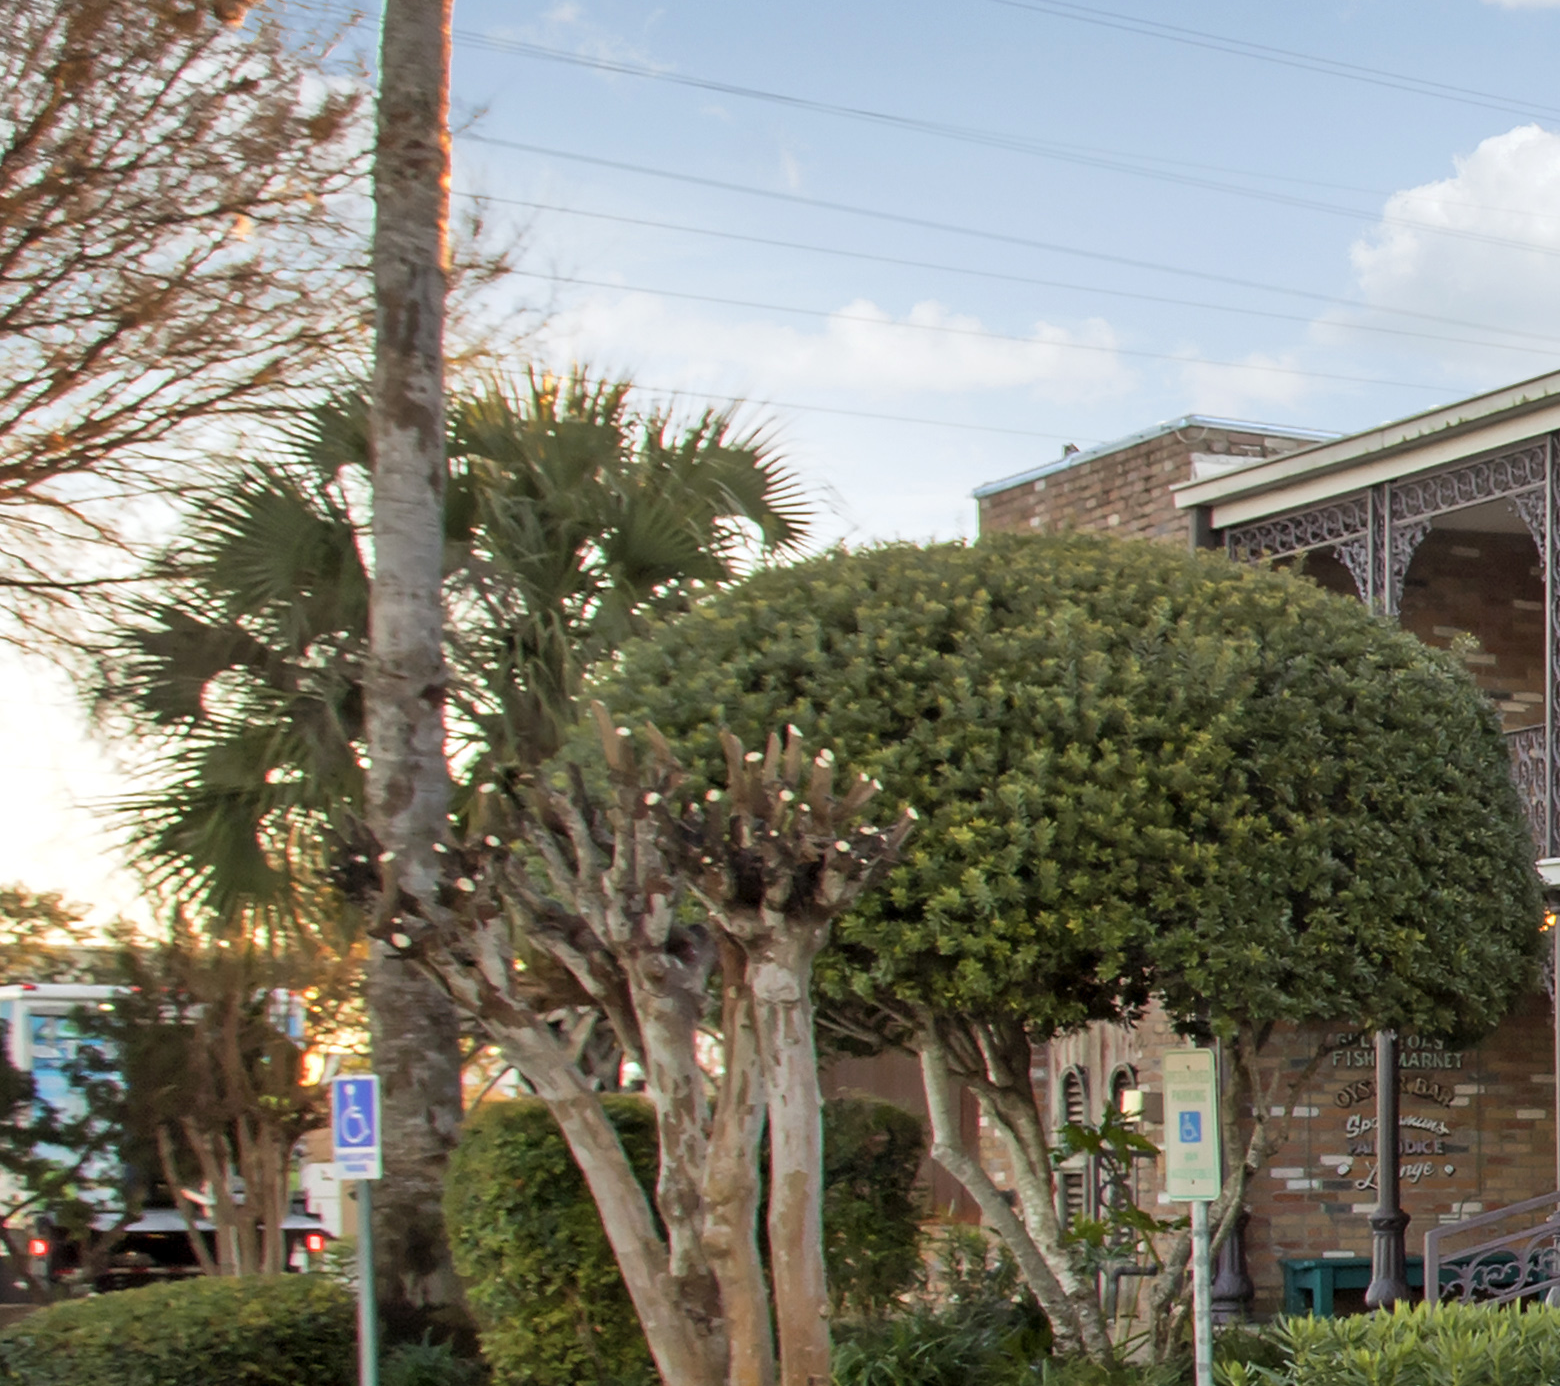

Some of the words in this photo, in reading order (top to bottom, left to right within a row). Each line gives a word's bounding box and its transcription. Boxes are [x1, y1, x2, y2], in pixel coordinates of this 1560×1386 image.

[1332, 1050, 1375, 1066] FISH
[1414, 1077, 1452, 1108] BAR
[1355, 1161, 1434, 1191] Lnge
